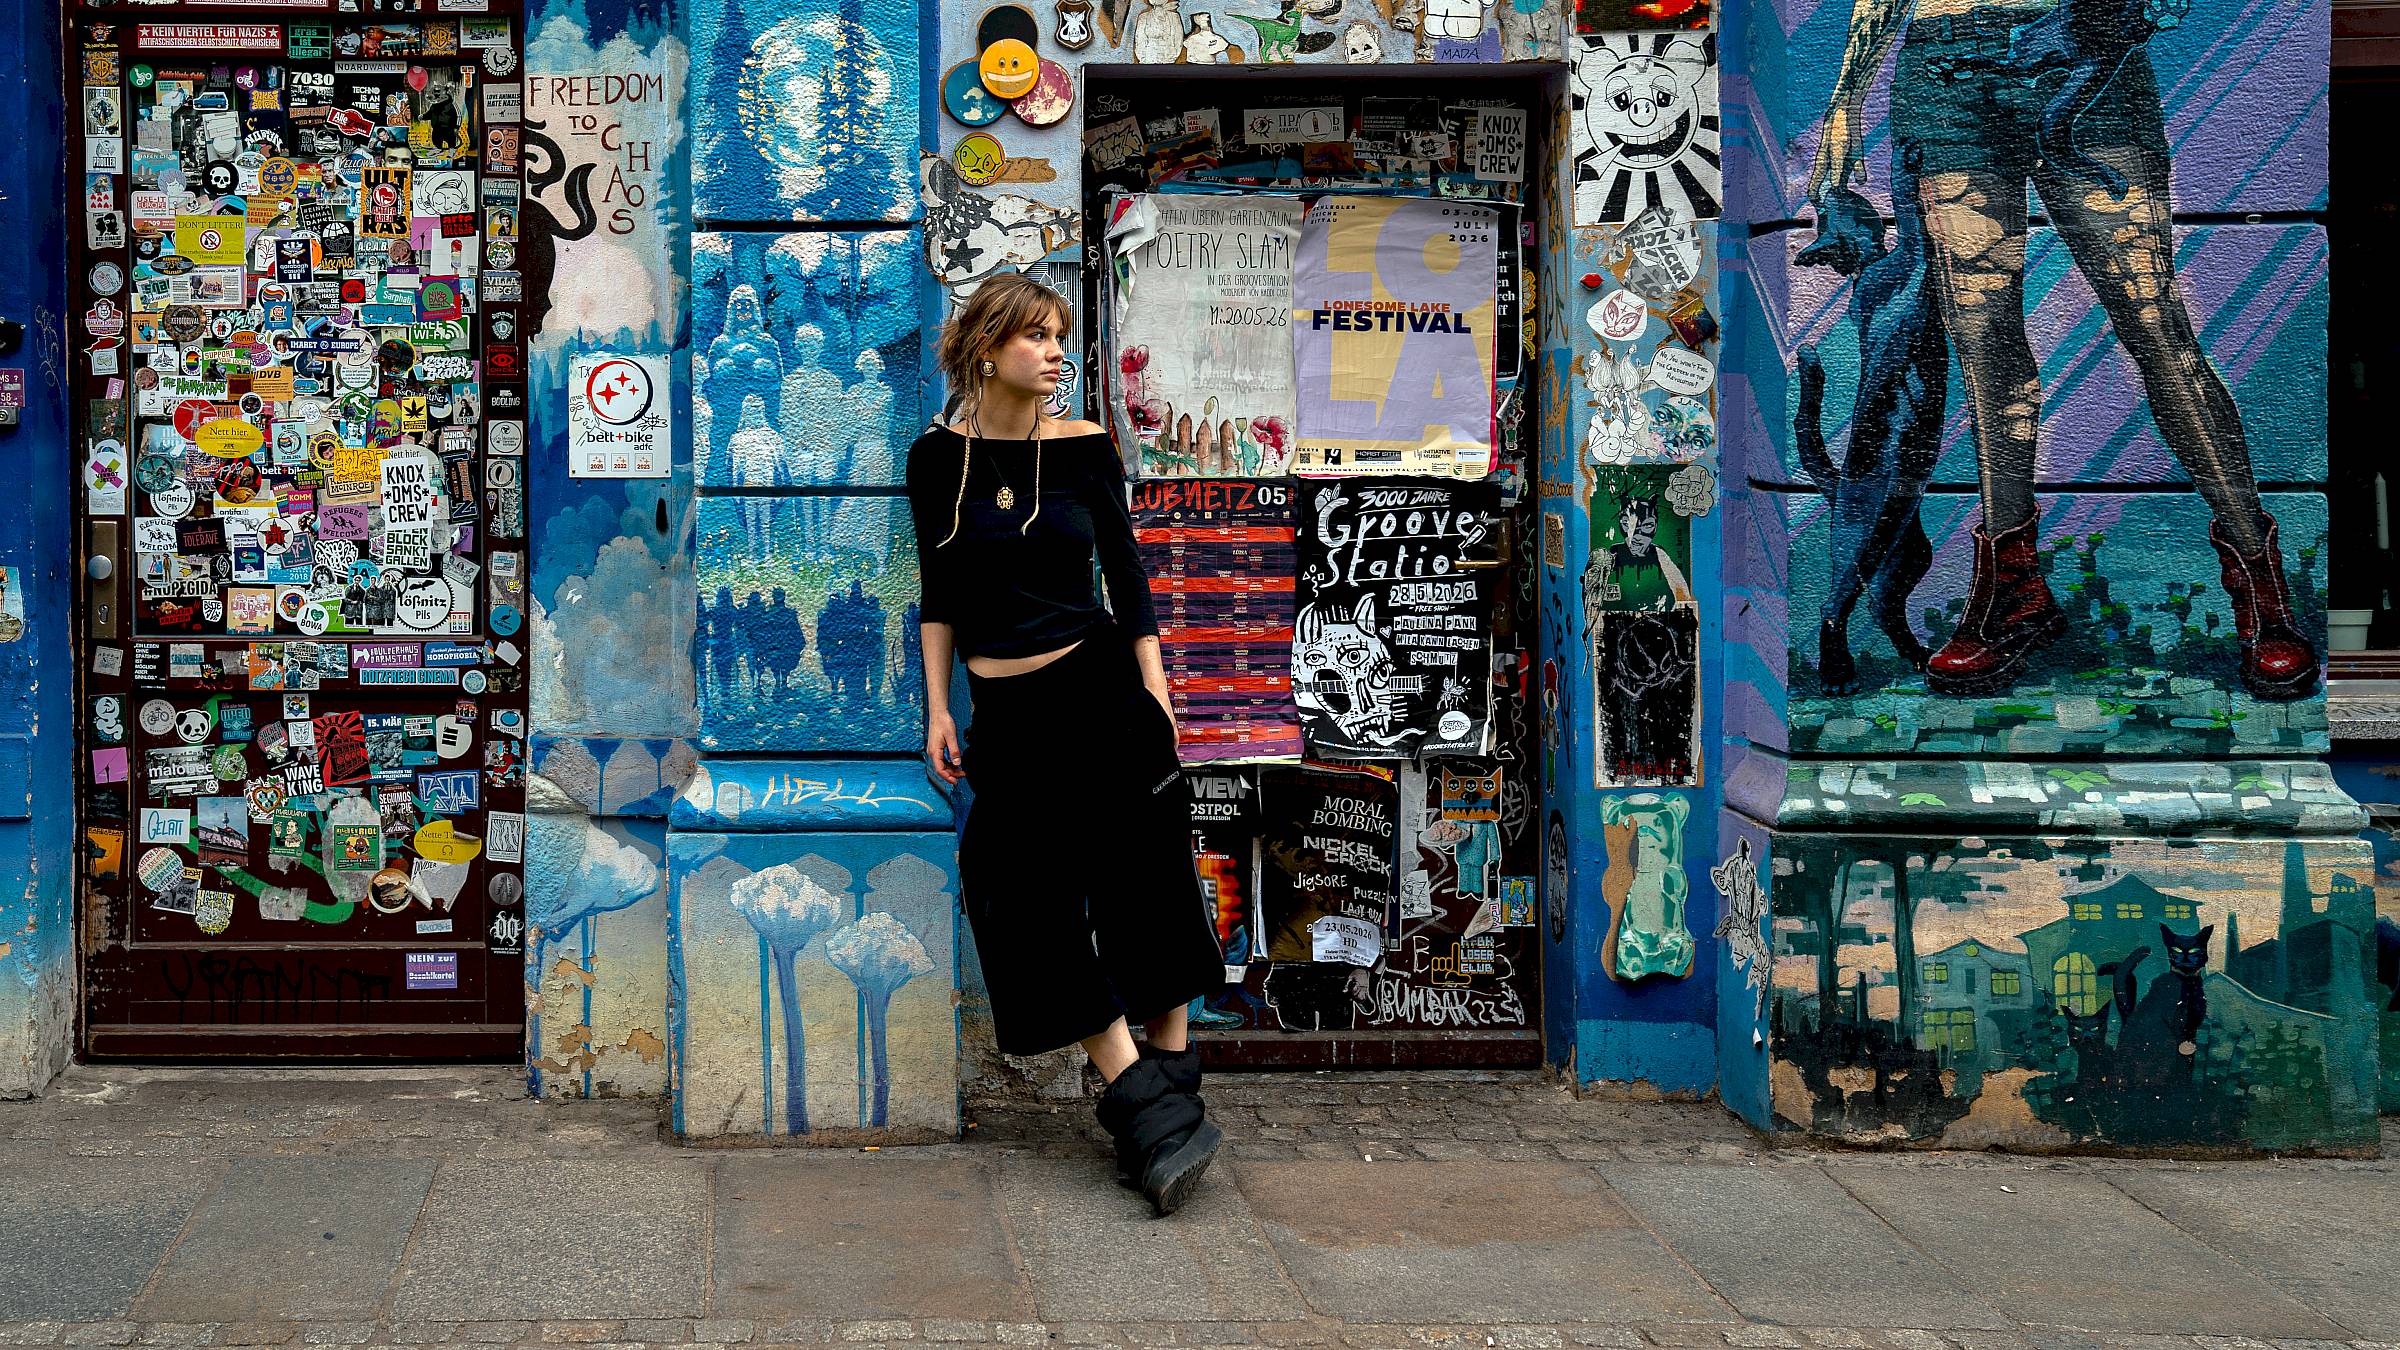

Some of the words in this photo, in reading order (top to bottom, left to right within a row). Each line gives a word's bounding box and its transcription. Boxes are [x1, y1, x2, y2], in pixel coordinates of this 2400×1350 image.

[151, 27, 175, 37] KEIN
[176, 27, 215, 37] VIERTEL
[238, 27, 267, 38] NAZIS
[294, 28, 317, 37] gras
[139, 38, 197, 46] ANTIFASCHISTISCHEN
[198, 38, 239, 46] SELBSTSCHUTZ
[240, 38, 280, 47] ORGANISIEREN
[1442, 47, 1479, 60] MADA
[292, 72, 335, 86] 7030
[352, 86, 380, 94] TECHNO
[529, 73, 663, 106] FREEDOM
[360, 94, 368, 102] IS
[369, 94, 380, 102] AN
[486, 93, 500, 101] LOVE
[501, 93, 520, 101] ANIMALS
[568, 114, 597, 131] TO
[1482, 114, 1521, 134] KNOX
[1486, 135, 1509, 154] DMS
[1479, 154, 1521, 175] CREW
[601, 122, 652, 235] CHAOS
[372, 207, 397, 215] ANTIFA
[1192, 207, 1225, 226] ÜBERN
[1229, 208, 1292, 227] GARTENZAUN
[375, 214, 393, 222] AREA
[178, 221, 206, 229] DON'T
[208, 221, 243, 229] LITTER!
[1453, 221, 1489, 230] JULI
[1448, 234, 1489, 243] 2026
[1146, 232, 1223, 270] POETRY
[1236, 233, 1290, 270] SLAM
[1207, 275, 1215, 286] IN
[1218, 275, 1232, 286] DER
[1234, 275, 1290, 287] GROOVESTATION
[1323, 300, 1406, 312] LONESOME
[1410, 302, 1451, 313] LAKE
[1312, 309, 1472, 334] FESTIVAL
[290, 341, 318, 350] IMARET
[331, 341, 359, 350] EUROPE
[204, 350, 234, 358] SUPPORT
[209, 427, 230, 436] Nett
[230, 428, 249, 437] hier.
[633, 443, 653, 451] adfc
[388, 450, 404, 459] Nett
[405, 450, 422, 459] hier.
[386, 465, 426, 484] KNOX
[158, 491, 188, 506] lößnitz
[288, 493, 312, 501] KOMM
[392, 485, 421, 503] DMS
[1130, 481, 1256, 512] LUBNETZ
[1257, 486, 1287, 505] 05
[1358, 490, 1407, 509] 3000
[1409, 491, 1452, 505] JAHRE
[167, 503, 178, 511] Pils
[323, 506, 364, 519] REFUGEES
[389, 503, 429, 523] CREW
[138, 518, 176, 530] REFUGEE
[1318, 497, 1475, 549] Groove
[322, 527, 364, 539] WELCOME
[386, 532, 428, 545] BLOCK
[138, 540, 177, 552] WELCOM
[183, 533, 220, 547] TOLERAVE
[386, 544, 428, 556] SANKT
[385, 555, 428, 567] GALLEN
[1319, 544, 1451, 589] Statio
[289, 573, 308, 581] 2018
[399, 595, 447, 613] lößnitz
[415, 610, 431, 620] Pils
[300, 619, 323, 632] BOWA
[1445, 616, 1477, 631] PANK
[1419, 635, 1444, 647] KANN
[370, 654, 418, 664] DARMSTADT
[426, 652, 478, 661] HOMOPHOBIA
[1410, 651, 1458, 666] SCHMUTZ
[418, 669, 456, 684] CINEMA
[368, 718, 380, 727] 15.
[382, 717, 401, 727] MÄR
[285, 763, 321, 782] WAVE
[379, 790, 412, 803] SEGUIMOS
[761, 773, 934, 813] HELL
[380, 804, 390, 816] EN
[1323, 795, 1385, 820] MORAL
[148, 811, 184, 841] GELATI
[1311, 809, 1393, 838] BOMBING
[1303, 835, 1380, 860] NICKEL
[1324, 922, 1373, 941] 23.05.2026
[1342, 937, 1359, 949] HD
[1460, 948, 1495, 961] LOSER
[1460, 962, 1495, 974] CLUB
